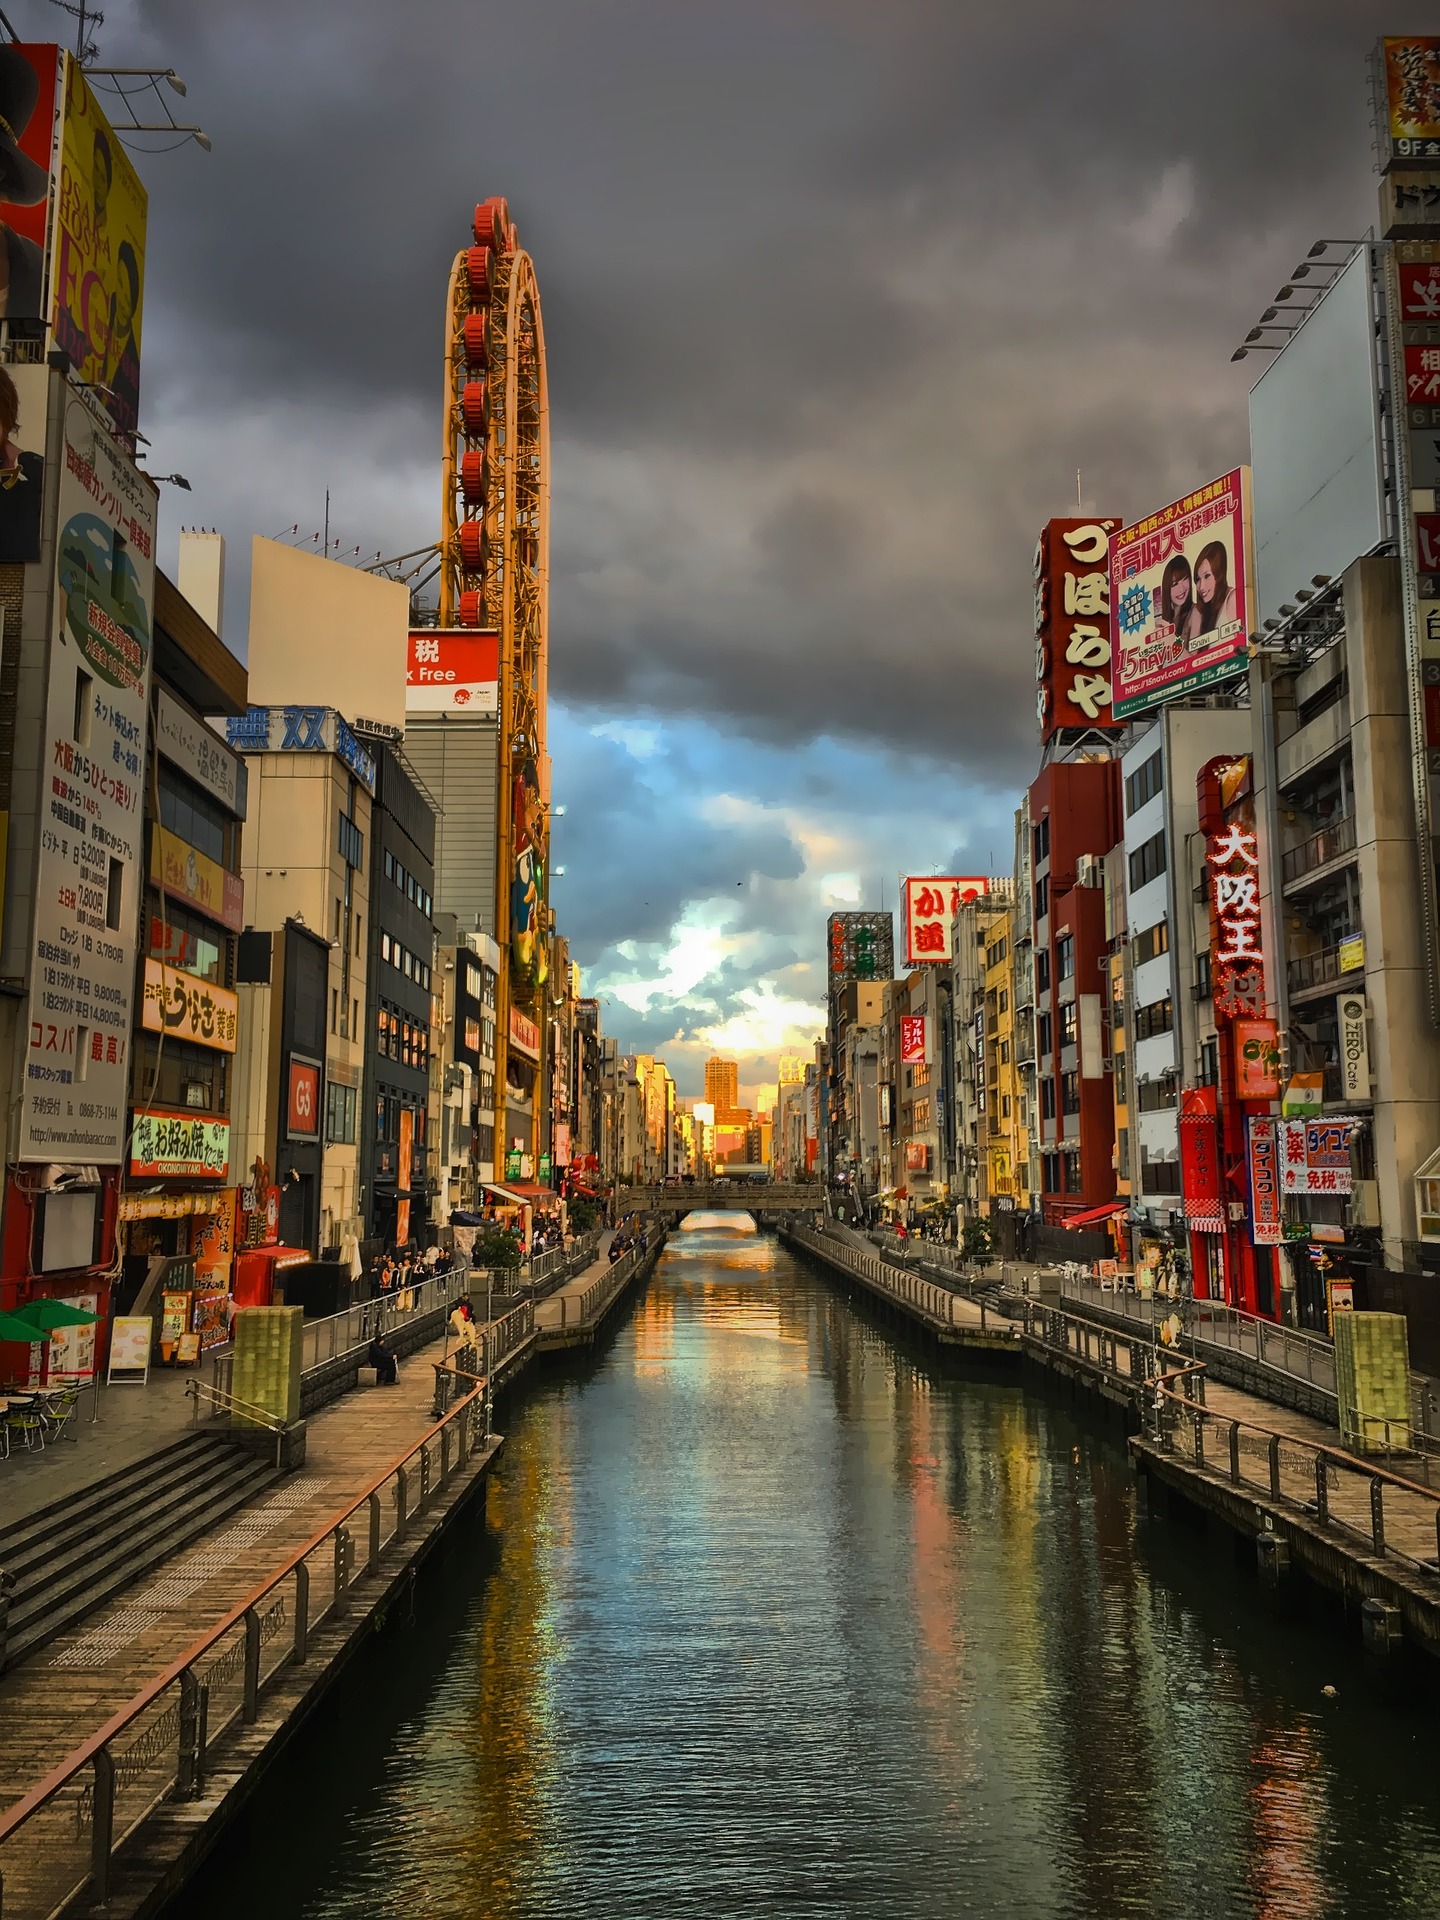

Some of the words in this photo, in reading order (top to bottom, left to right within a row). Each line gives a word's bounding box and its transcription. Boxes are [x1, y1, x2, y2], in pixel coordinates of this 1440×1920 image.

[1398, 139, 1421, 156] 9F
[1178, 494, 1239, 539] お仕事探し
[1120, 526, 1184, 582] 高収入
[415, 639, 440, 663] 税
[419, 667, 456, 681] Free
[1124, 663, 1188, 696] http://15navi.com/
[58, 885, 77, 911] 土日祝
[1207, 824, 1264, 1017] 大阪王将
[31, 1021, 75, 1056] コスパ
[903, 1023, 913, 1052] ドラッグ
[912, 1019, 923, 1046] ツルハ
[1345, 1022, 1359, 1061] ZERO
[32, 1096, 61, 1117] 予約受付
[79, 1102, 117, 1121] 0868-75-1144
[296, 1080, 311, 1117] G3
[155, 1117, 204, 1160] お好み焼
[157, 1162, 201, 1175] OKONOMIYAKI
[1194, 1126, 1209, 1188] 大阪みやげ
[1307, 1170, 1337, 1189] 免税
